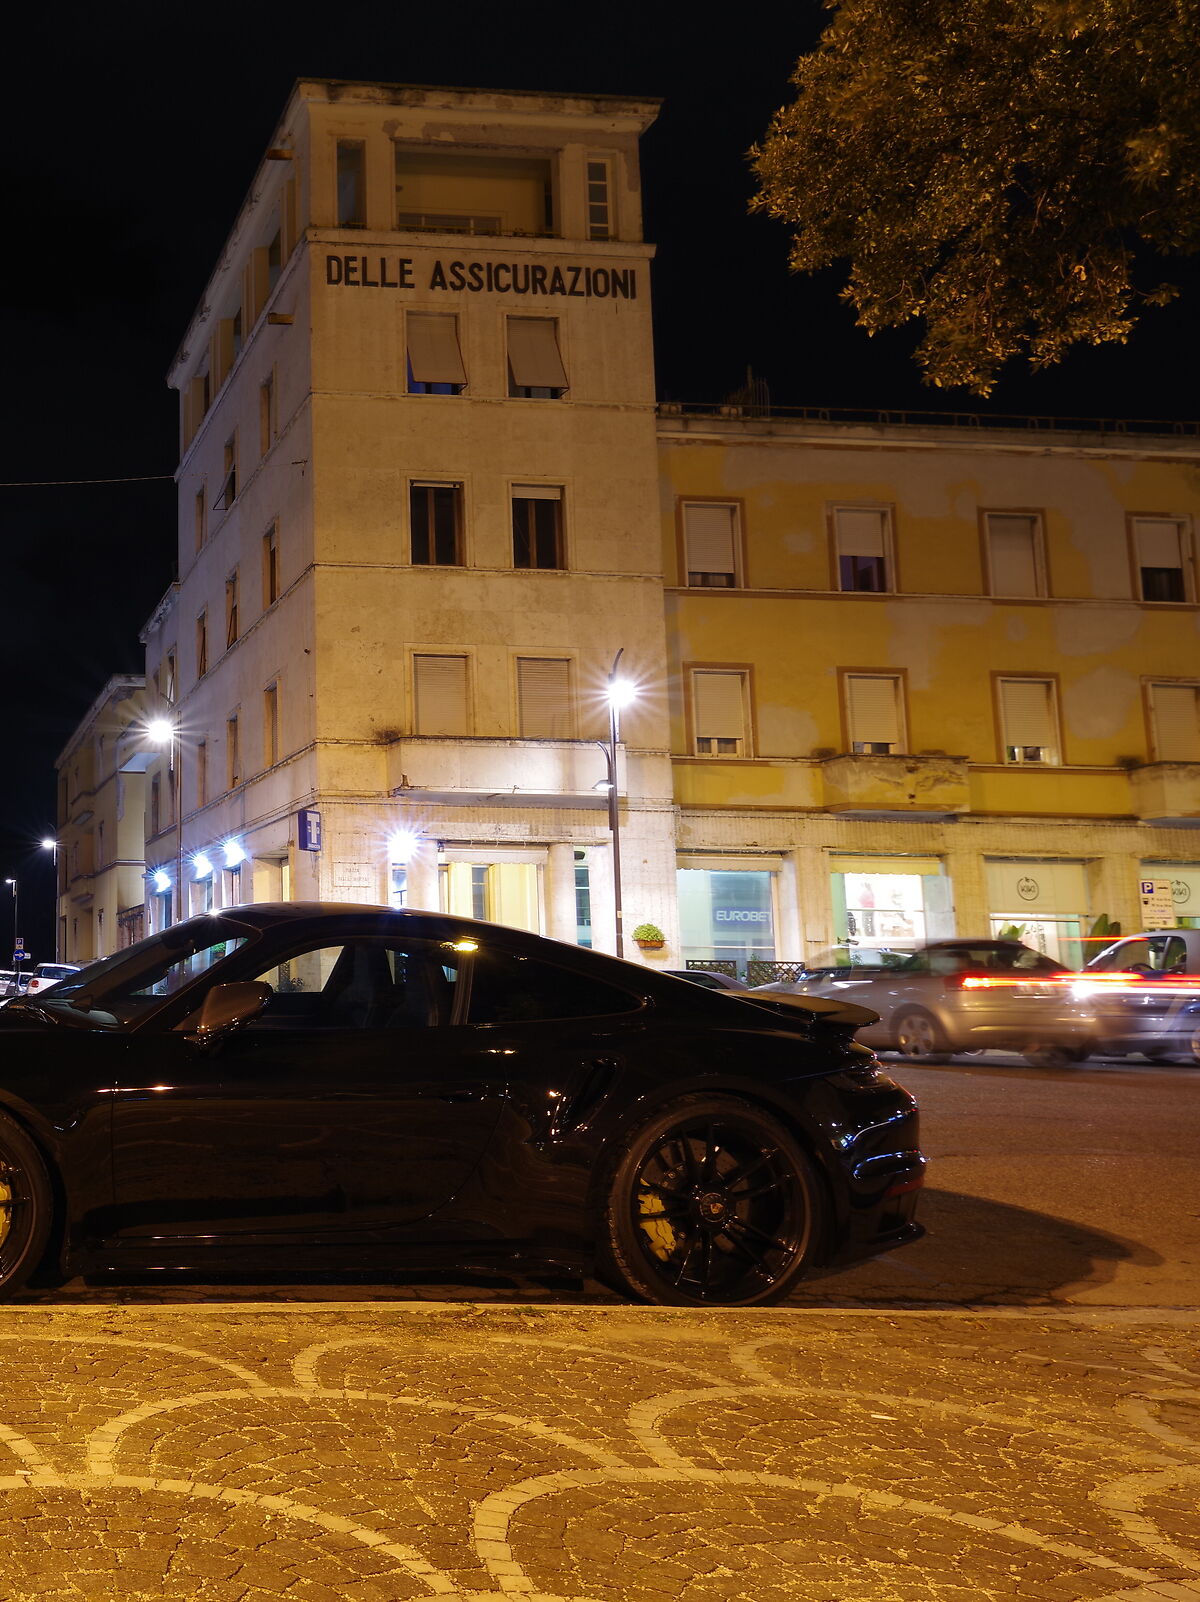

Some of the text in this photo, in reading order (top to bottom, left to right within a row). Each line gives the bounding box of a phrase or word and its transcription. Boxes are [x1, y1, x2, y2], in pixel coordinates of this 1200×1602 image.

[326, 255, 637, 299] DELLE ASSICURAZIONI
[306, 812, 320, 844] T
